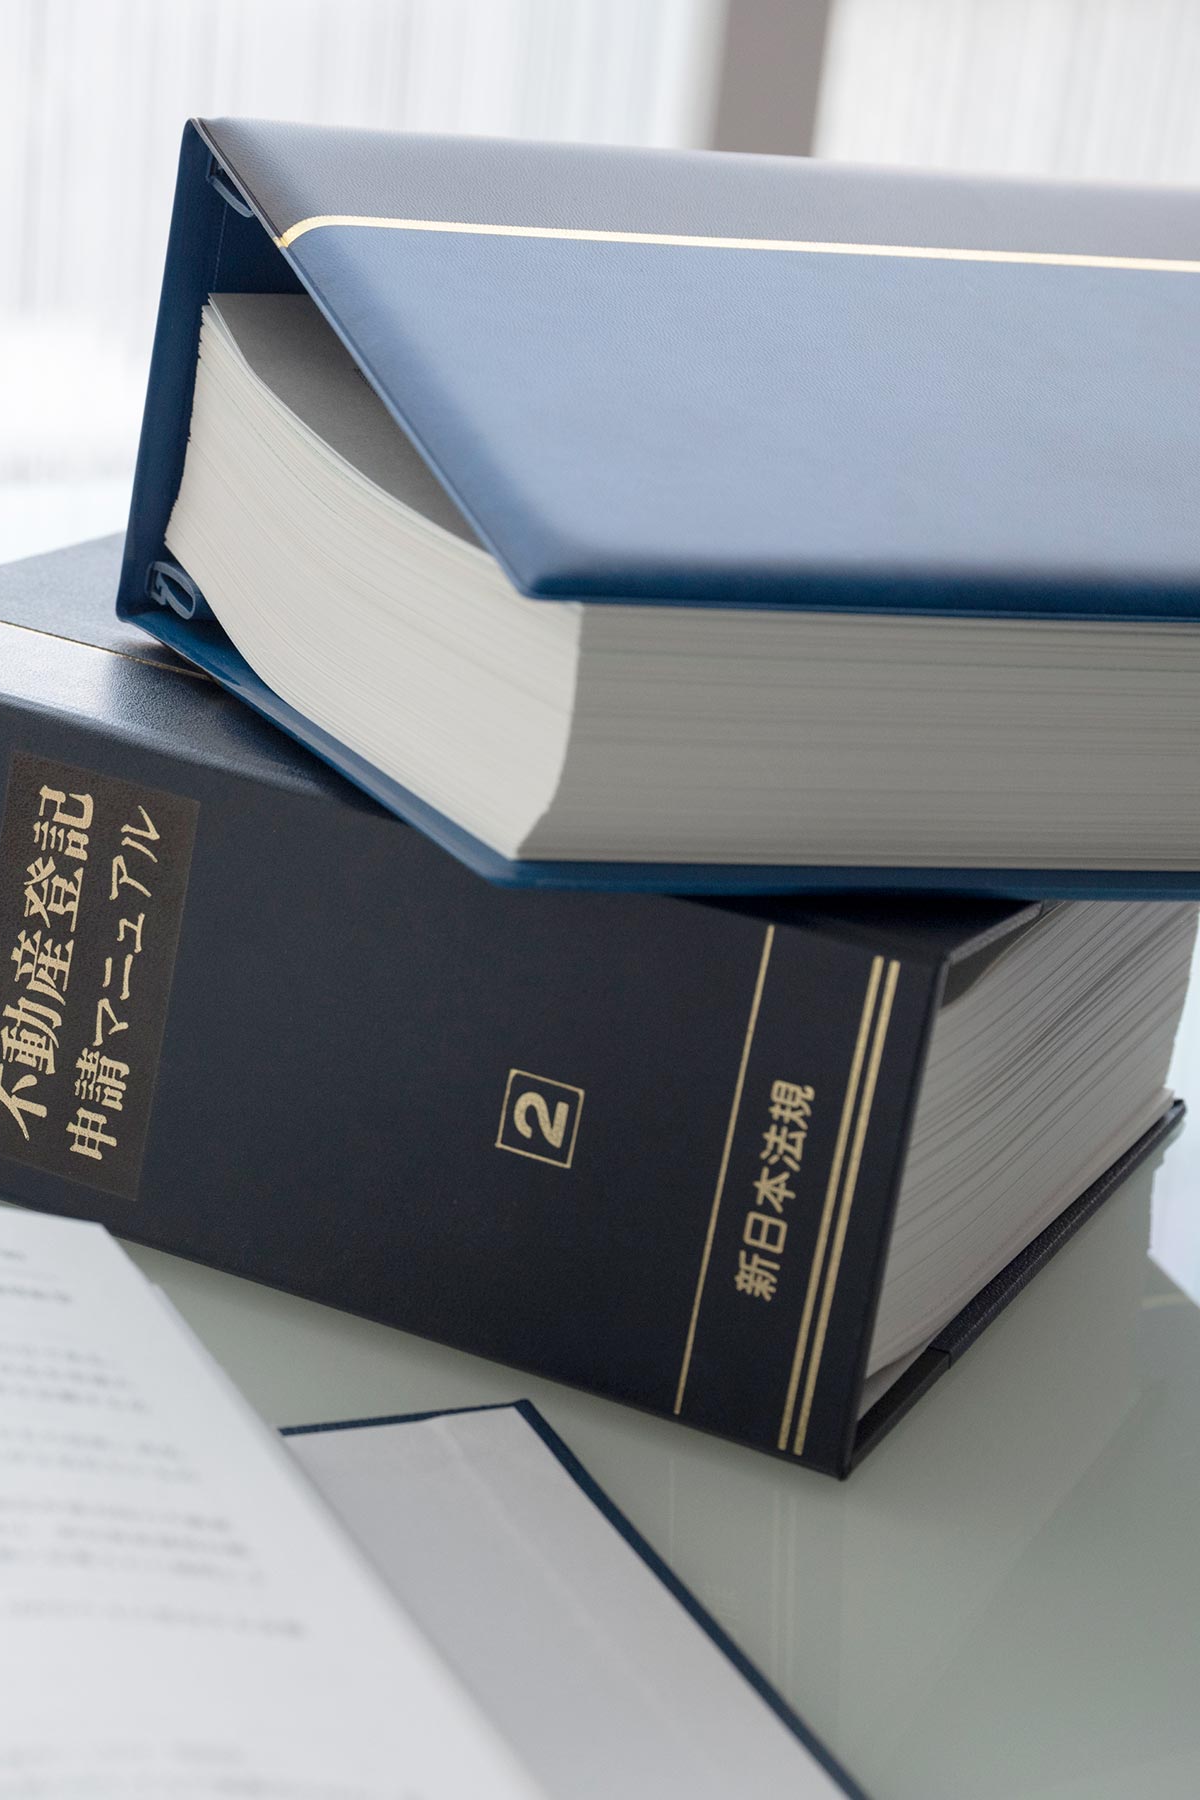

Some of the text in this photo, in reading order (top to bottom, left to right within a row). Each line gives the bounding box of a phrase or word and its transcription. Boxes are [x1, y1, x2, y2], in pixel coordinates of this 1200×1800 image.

[67, 806, 160, 1160] 申請マニュアル
[514, 1091, 569, 1148] 2
[735, 1080, 815, 1301] 新日本法規
